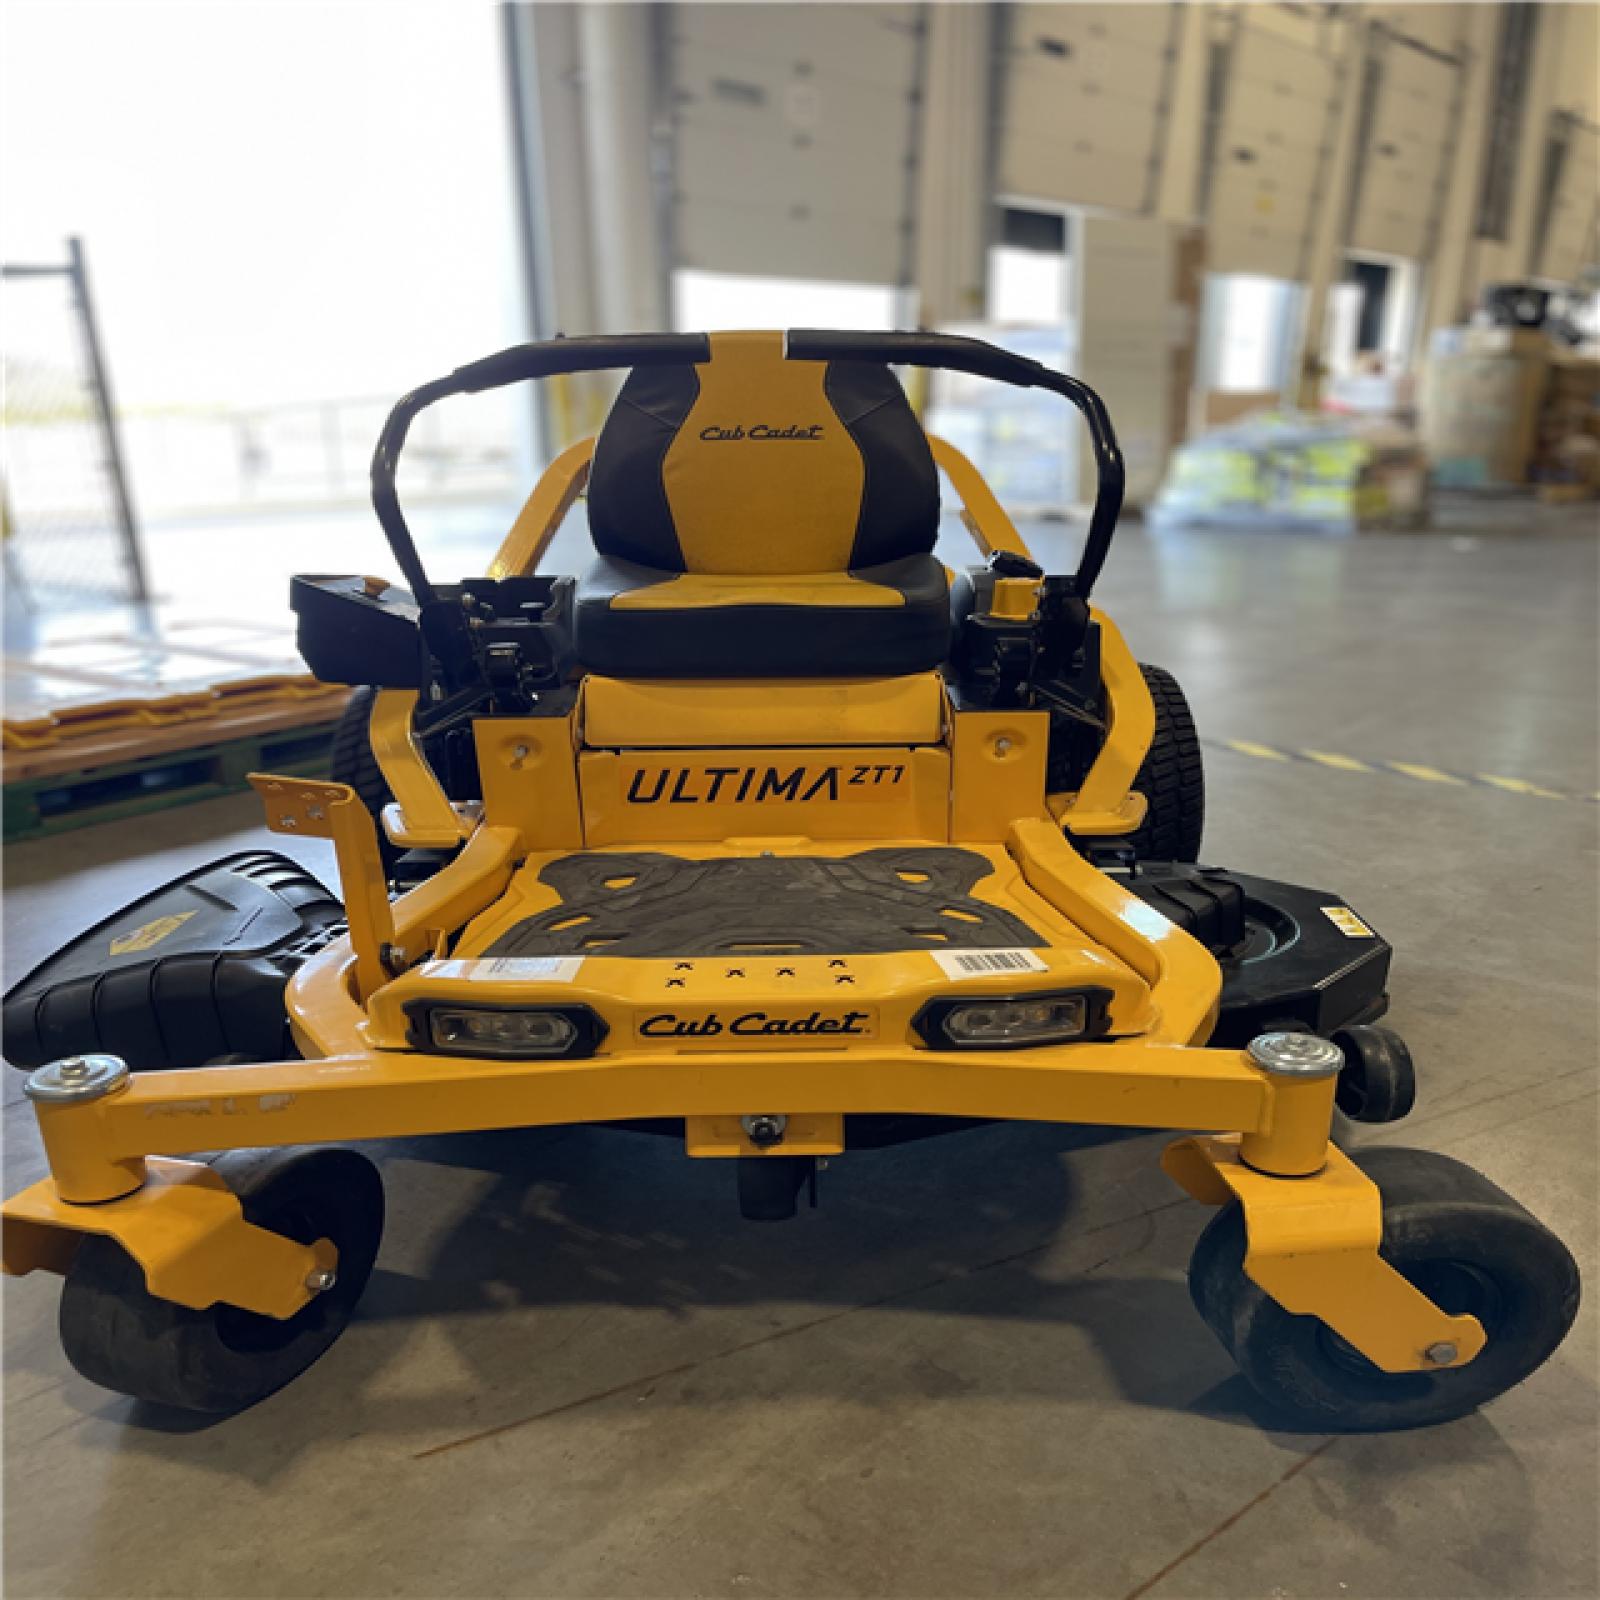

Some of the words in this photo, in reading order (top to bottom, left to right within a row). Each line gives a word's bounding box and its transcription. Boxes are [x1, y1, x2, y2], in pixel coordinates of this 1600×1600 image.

[699, 424, 745, 441] Cub
[748, 424, 825, 441] Cadet
[627, 766, 841, 803] ULTIMA
[847, 764, 905, 785] ZT1
[639, 1013, 723, 1037] Cub
[729, 1011, 869, 1036] Cadet
